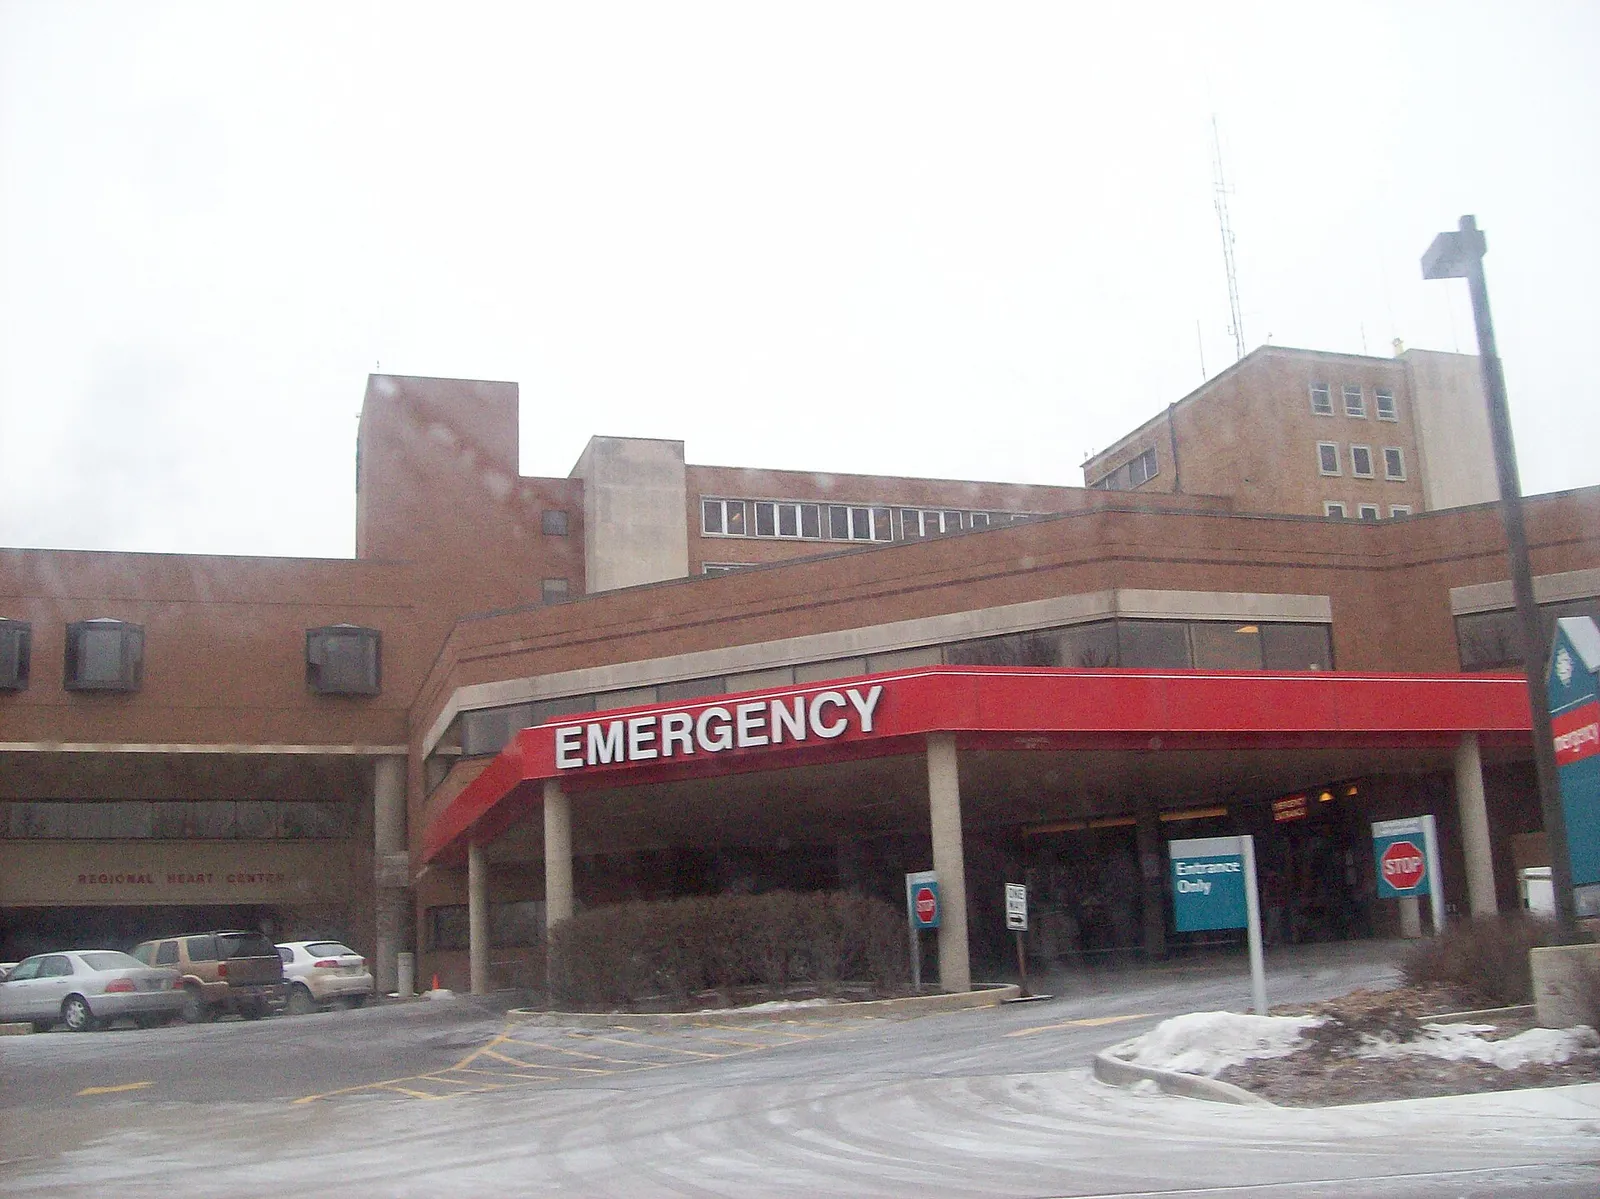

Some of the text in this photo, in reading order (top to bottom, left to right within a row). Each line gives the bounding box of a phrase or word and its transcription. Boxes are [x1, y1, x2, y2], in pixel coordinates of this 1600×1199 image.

[554, 685, 883, 770] EMERGENCY
[1176, 862, 1241, 876] Entrance
[1385, 856, 1421, 875] STOP
[78, 873, 284, 884] REGIONAL HEART CENTER
[1008, 887, 1024, 900] ONE
[1177, 879, 1212, 896] Only
[917, 900, 935, 912] STOP
